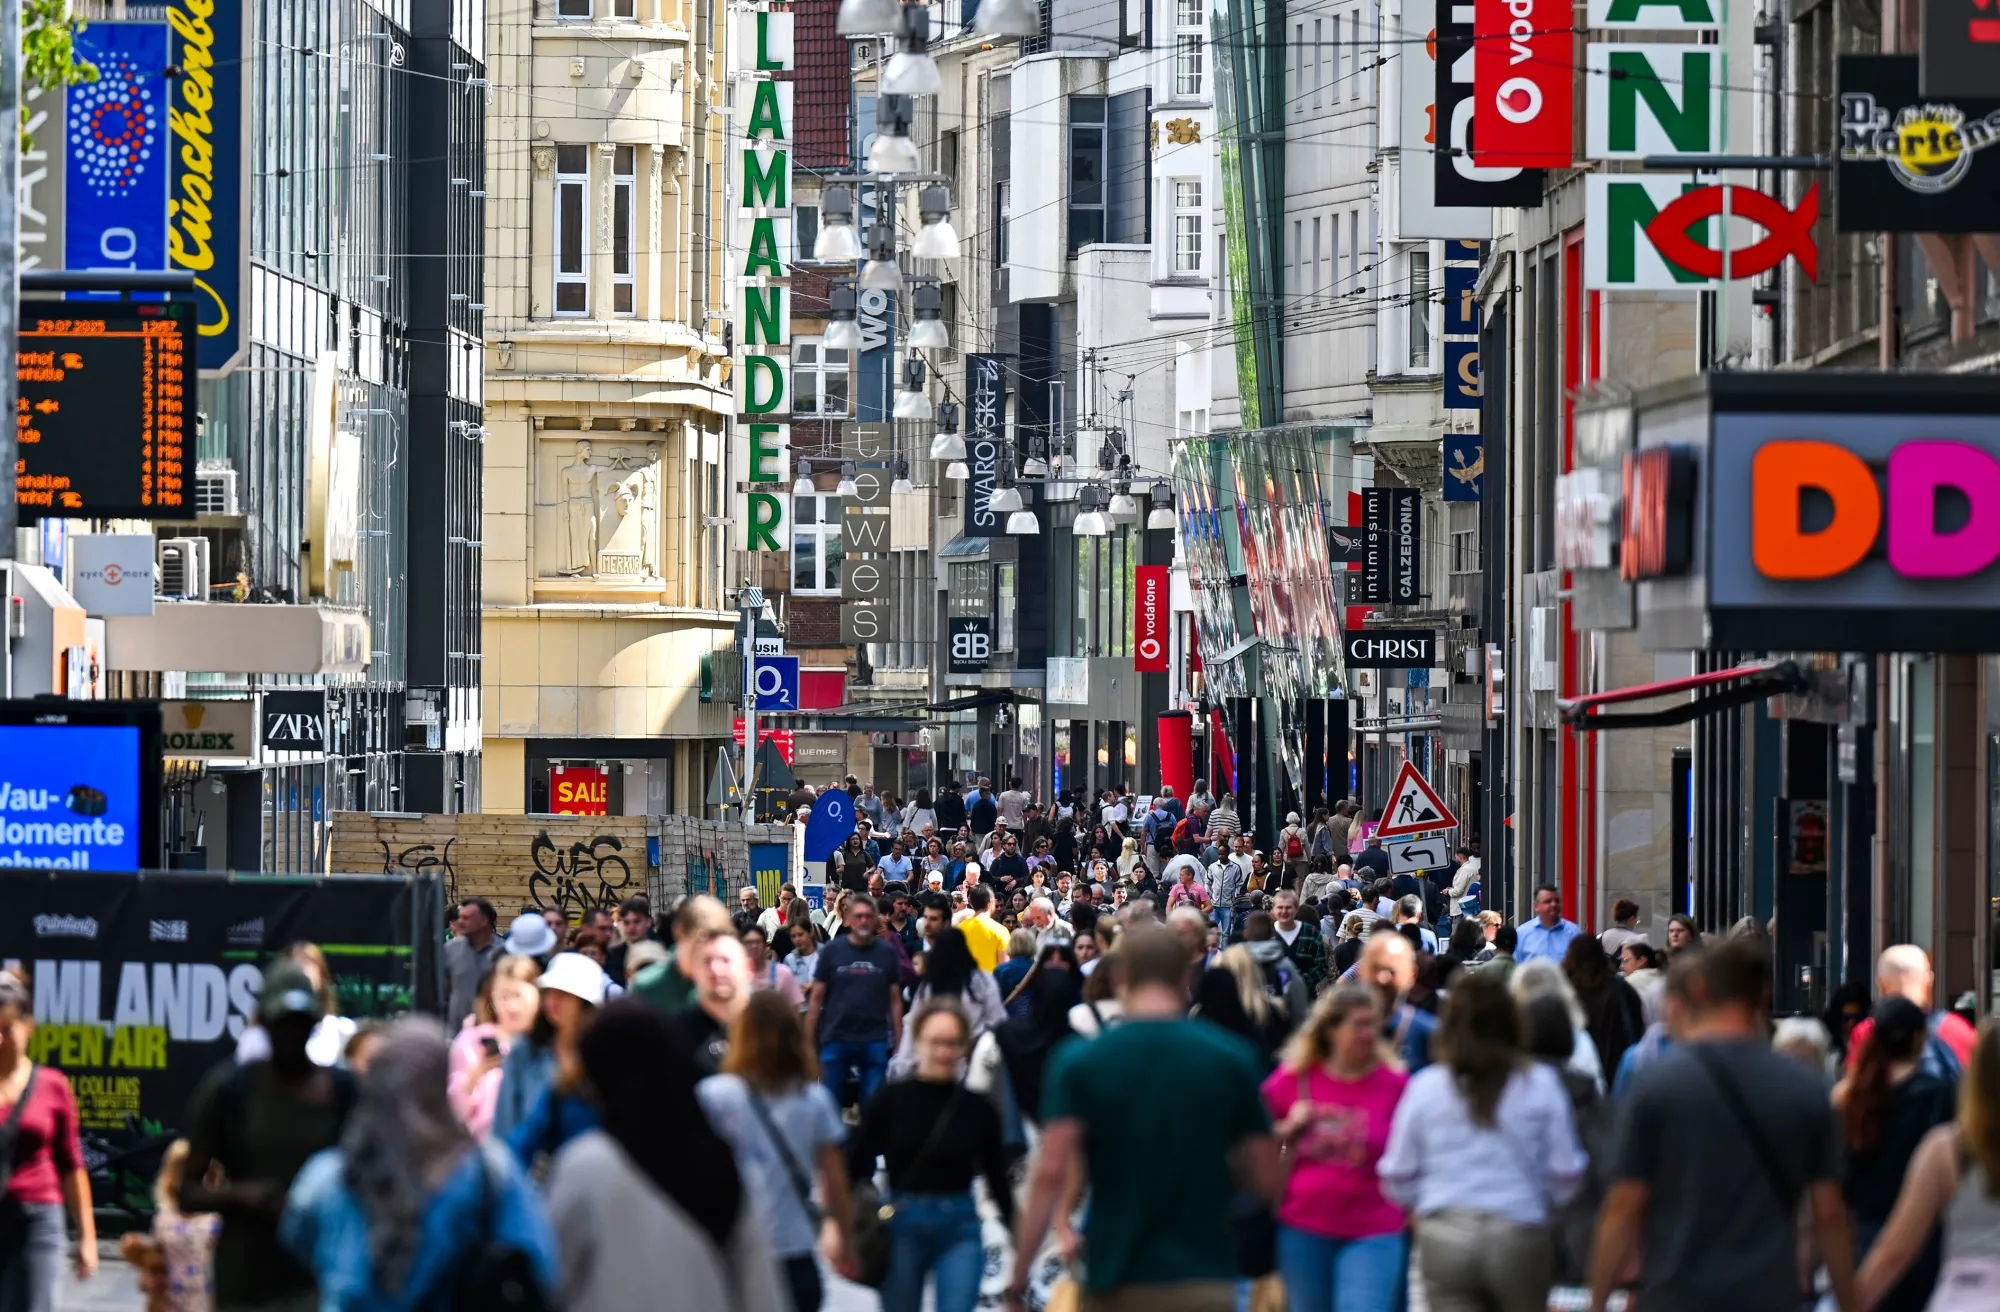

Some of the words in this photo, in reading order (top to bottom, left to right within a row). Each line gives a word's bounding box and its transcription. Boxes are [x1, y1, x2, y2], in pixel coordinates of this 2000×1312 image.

[846, 426, 885, 638] tewes
[1400, 496, 1412, 598] CALZEDONIA
[602, 555, 640, 574] MERKUR
[1147, 579, 1156, 636] vodafone
[755, 644, 779, 653] USH
[1351, 639, 1428, 659] CHRIST
[268, 713, 323, 740] ZARA
[799, 748, 838, 756] WEMPE
[558, 781, 607, 803] SALE
[109, 1025, 168, 1069] AIR
